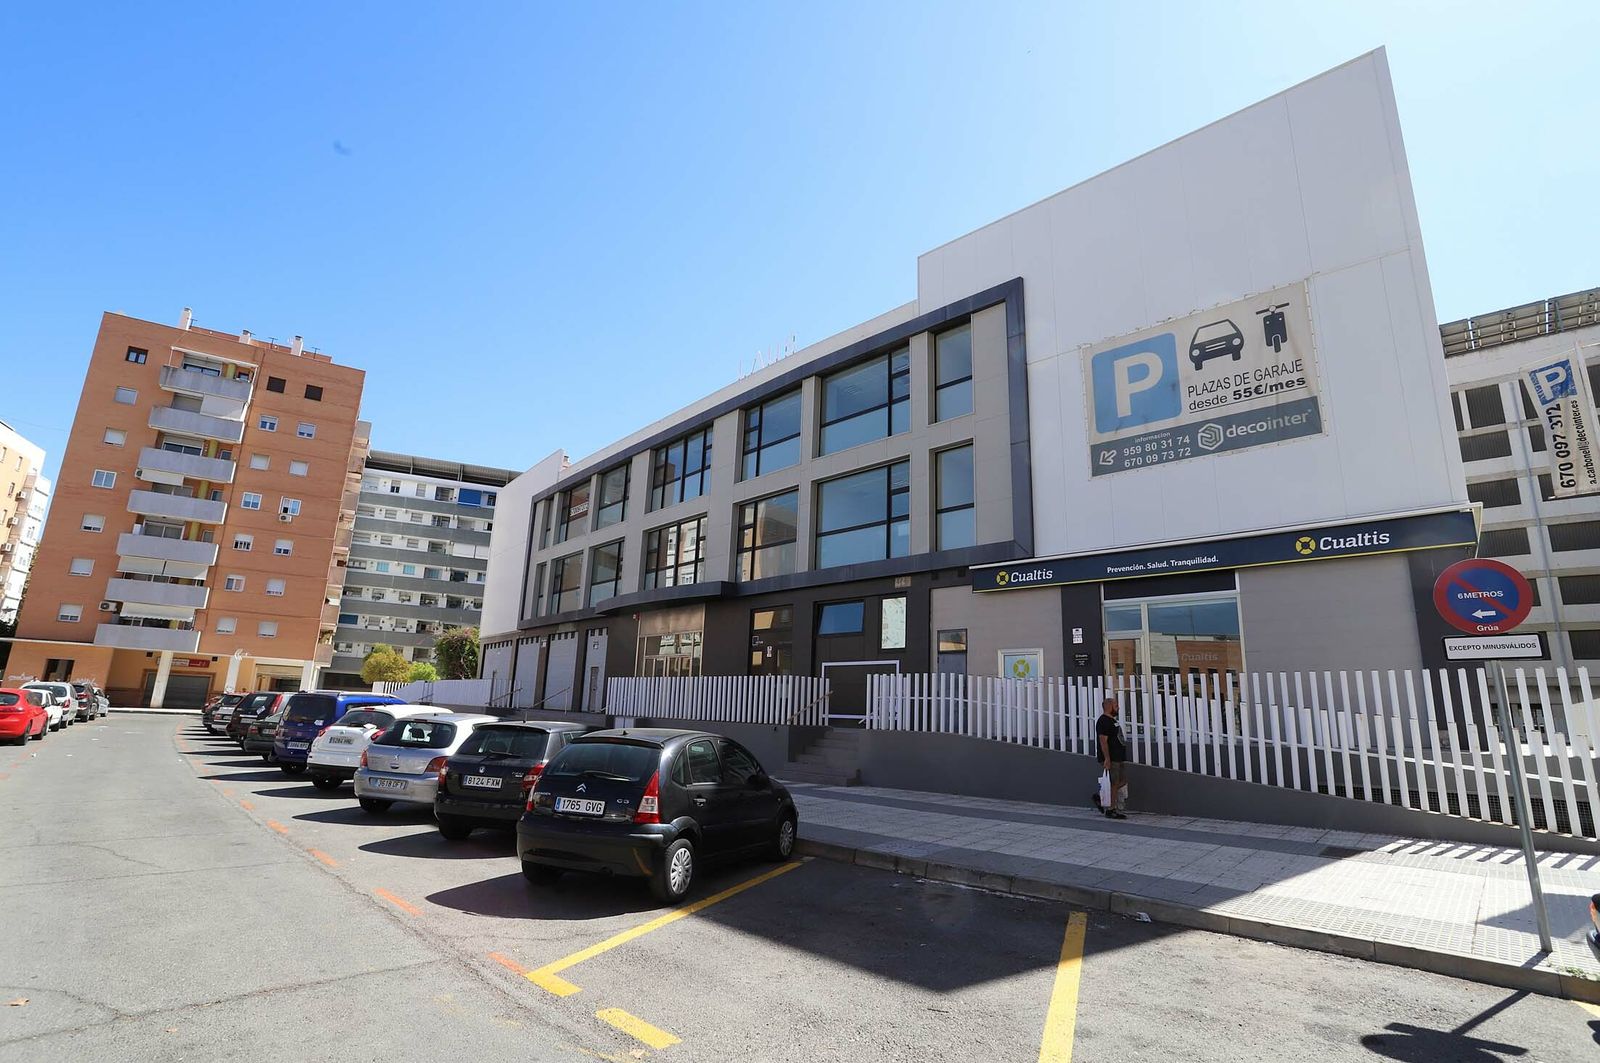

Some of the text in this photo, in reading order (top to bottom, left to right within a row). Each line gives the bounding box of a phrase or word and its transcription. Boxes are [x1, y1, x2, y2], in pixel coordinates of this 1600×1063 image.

[1114, 352, 1163, 417] P
[1188, 359, 1304, 398] PLAZAS DE GARAJE
[1536, 366, 1567, 401] P
[1189, 377, 1306, 411] desde 55€/mes
[1226, 412, 1309, 438] decointer
[1123, 435, 1191, 456] 959 80 31 74
[1546, 403, 1577, 488] 670 097 372
[1124, 447, 1191, 468] 670 09 73 72
[1319, 531, 1391, 551] Cualtis
[1107, 555, 1219, 574] Prevención. Salud. Tranquilidad.
[1010, 569, 1053, 583] Cualtis
[1476, 624, 1500, 632] Grúa
[1449, 642, 1537, 652] EXCEPTO MINUSVÁLIDOS
[467, 776, 485, 785] 8124
[562, 798, 602, 813] 1765 GVG
